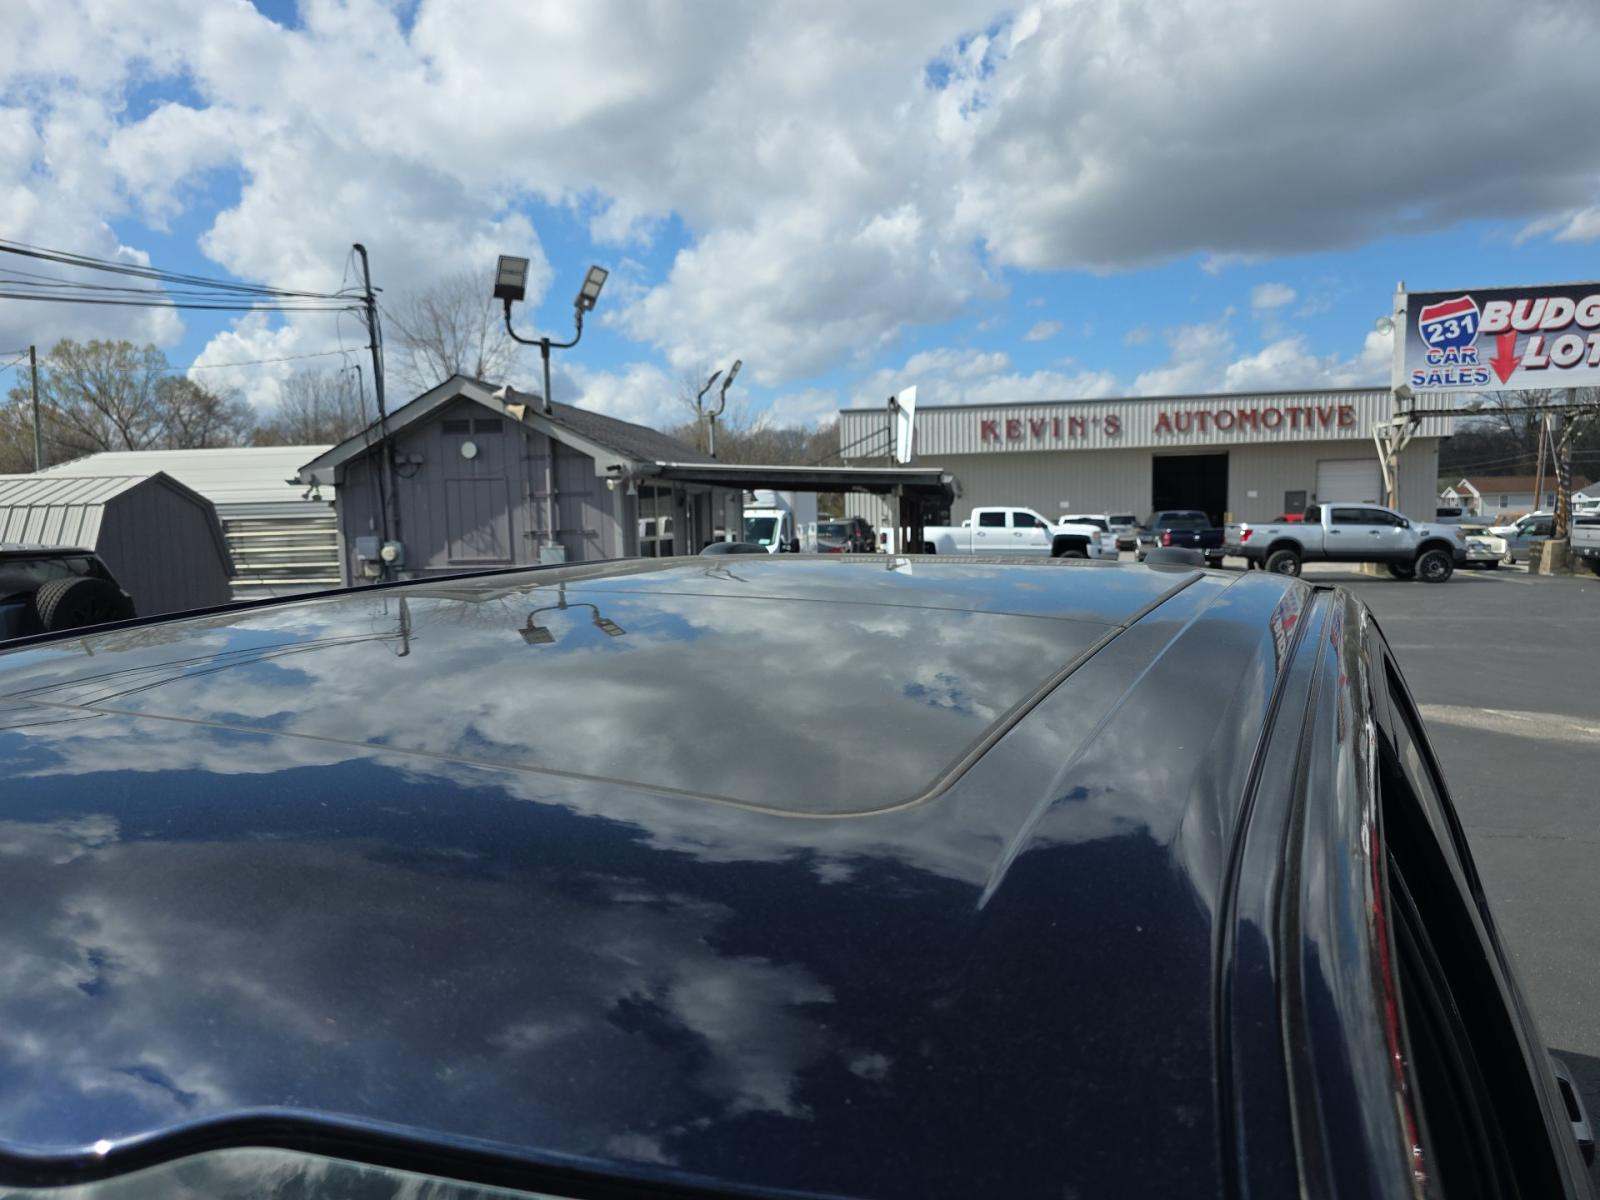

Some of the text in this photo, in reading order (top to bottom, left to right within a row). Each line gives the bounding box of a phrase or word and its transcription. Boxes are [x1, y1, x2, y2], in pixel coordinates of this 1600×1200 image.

[1427, 315, 1474, 343] 231
[1478, 294, 1600, 336] BUDG
[1426, 348, 1477, 365] CAR
[1412, 367, 1488, 386] SALES
[980, 405, 1356, 441] KEVIN'S AUTOMOTIVE
